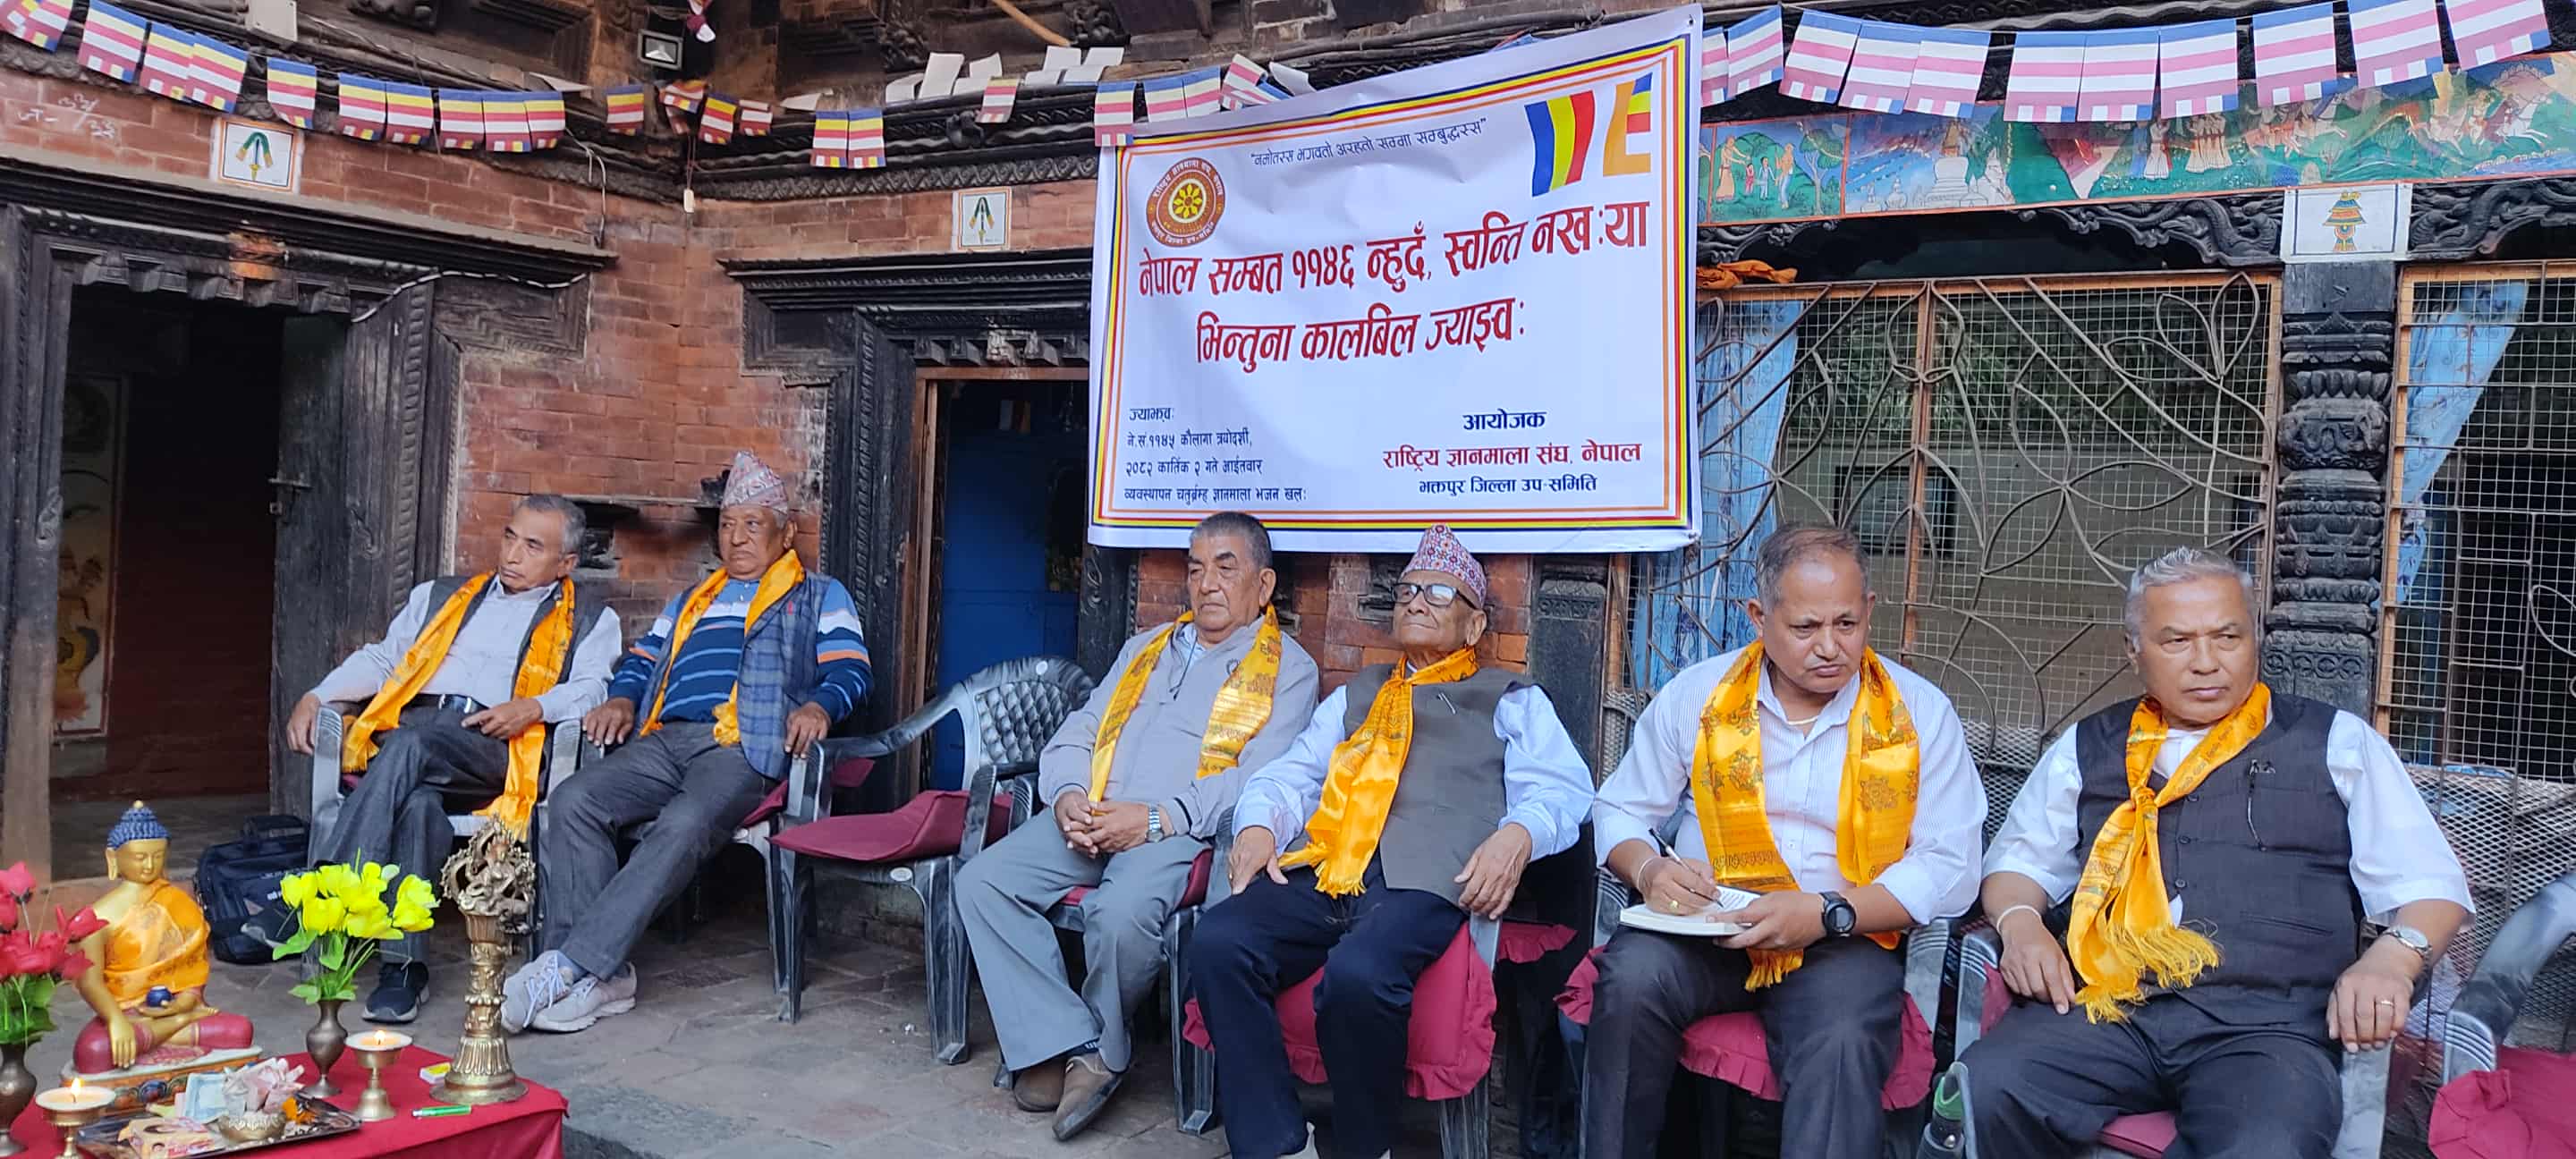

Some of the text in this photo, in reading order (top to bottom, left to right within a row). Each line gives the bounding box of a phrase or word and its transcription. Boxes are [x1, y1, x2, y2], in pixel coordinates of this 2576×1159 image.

[1139, 247, 1203, 298] नेपाल
[1208, 252, 1284, 296] सम्बत
[1292, 244, 1354, 290] ११४६
[1443, 210, 1529, 277] स्वन्ति
[1196, 310, 1297, 374] भिन्तुना
[1301, 302, 1422, 361] कालबिल
[1462, 408, 1547, 430] आयोजक
[1383, 444, 1440, 472] राष्ट्रिय
[1445, 446, 1530, 467] ज्ञानमाला
[1580, 438, 1642, 462] नेपाल
[1125, 461, 1153, 477] २०८२
[1194, 461, 1200, 477] २
[1205, 457, 1219, 473] गते
[1212, 487, 1252, 503] ज्ञानमाला
[1255, 487, 1280, 502] भजन
[1419, 479, 1467, 496] भक्तपुर
[1470, 475, 1518, 493] जिल्ला
